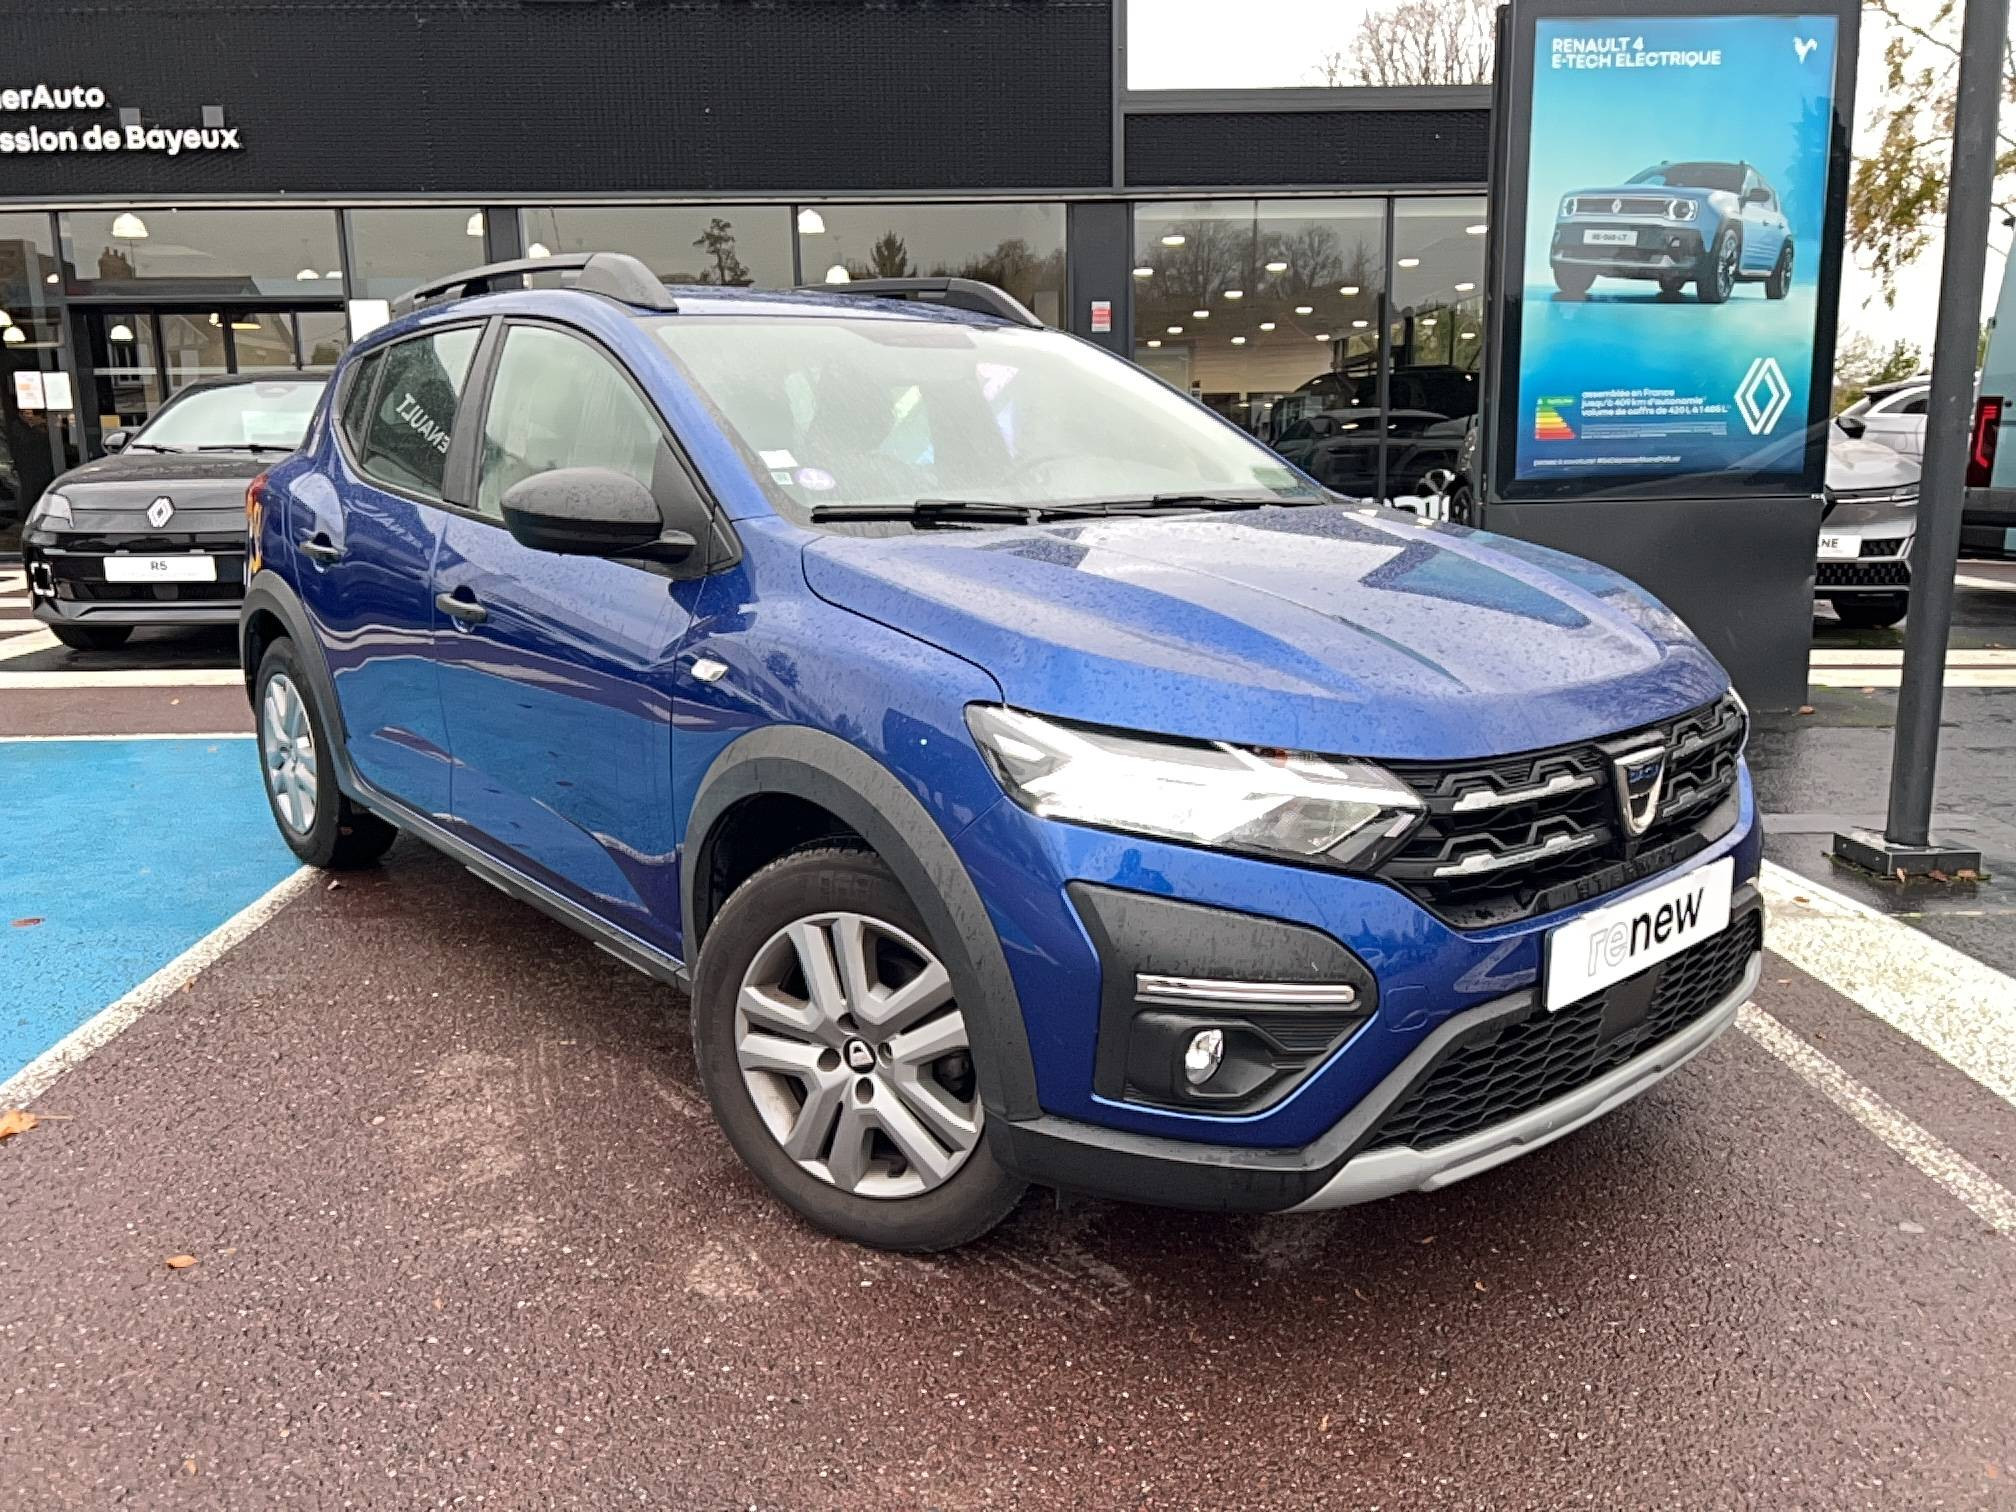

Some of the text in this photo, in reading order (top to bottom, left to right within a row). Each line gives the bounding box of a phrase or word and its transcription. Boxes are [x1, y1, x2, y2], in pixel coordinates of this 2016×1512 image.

[1552, 36, 1644, 53] RENAULT 4
[1551, 50, 1722, 69] E-TECH ELECTRIQUE
[0, 84, 105, 109] erAuto
[82, 124, 121, 151] de
[124, 125, 240, 155] Bayeux
[1587, 887, 1704, 977] renew
